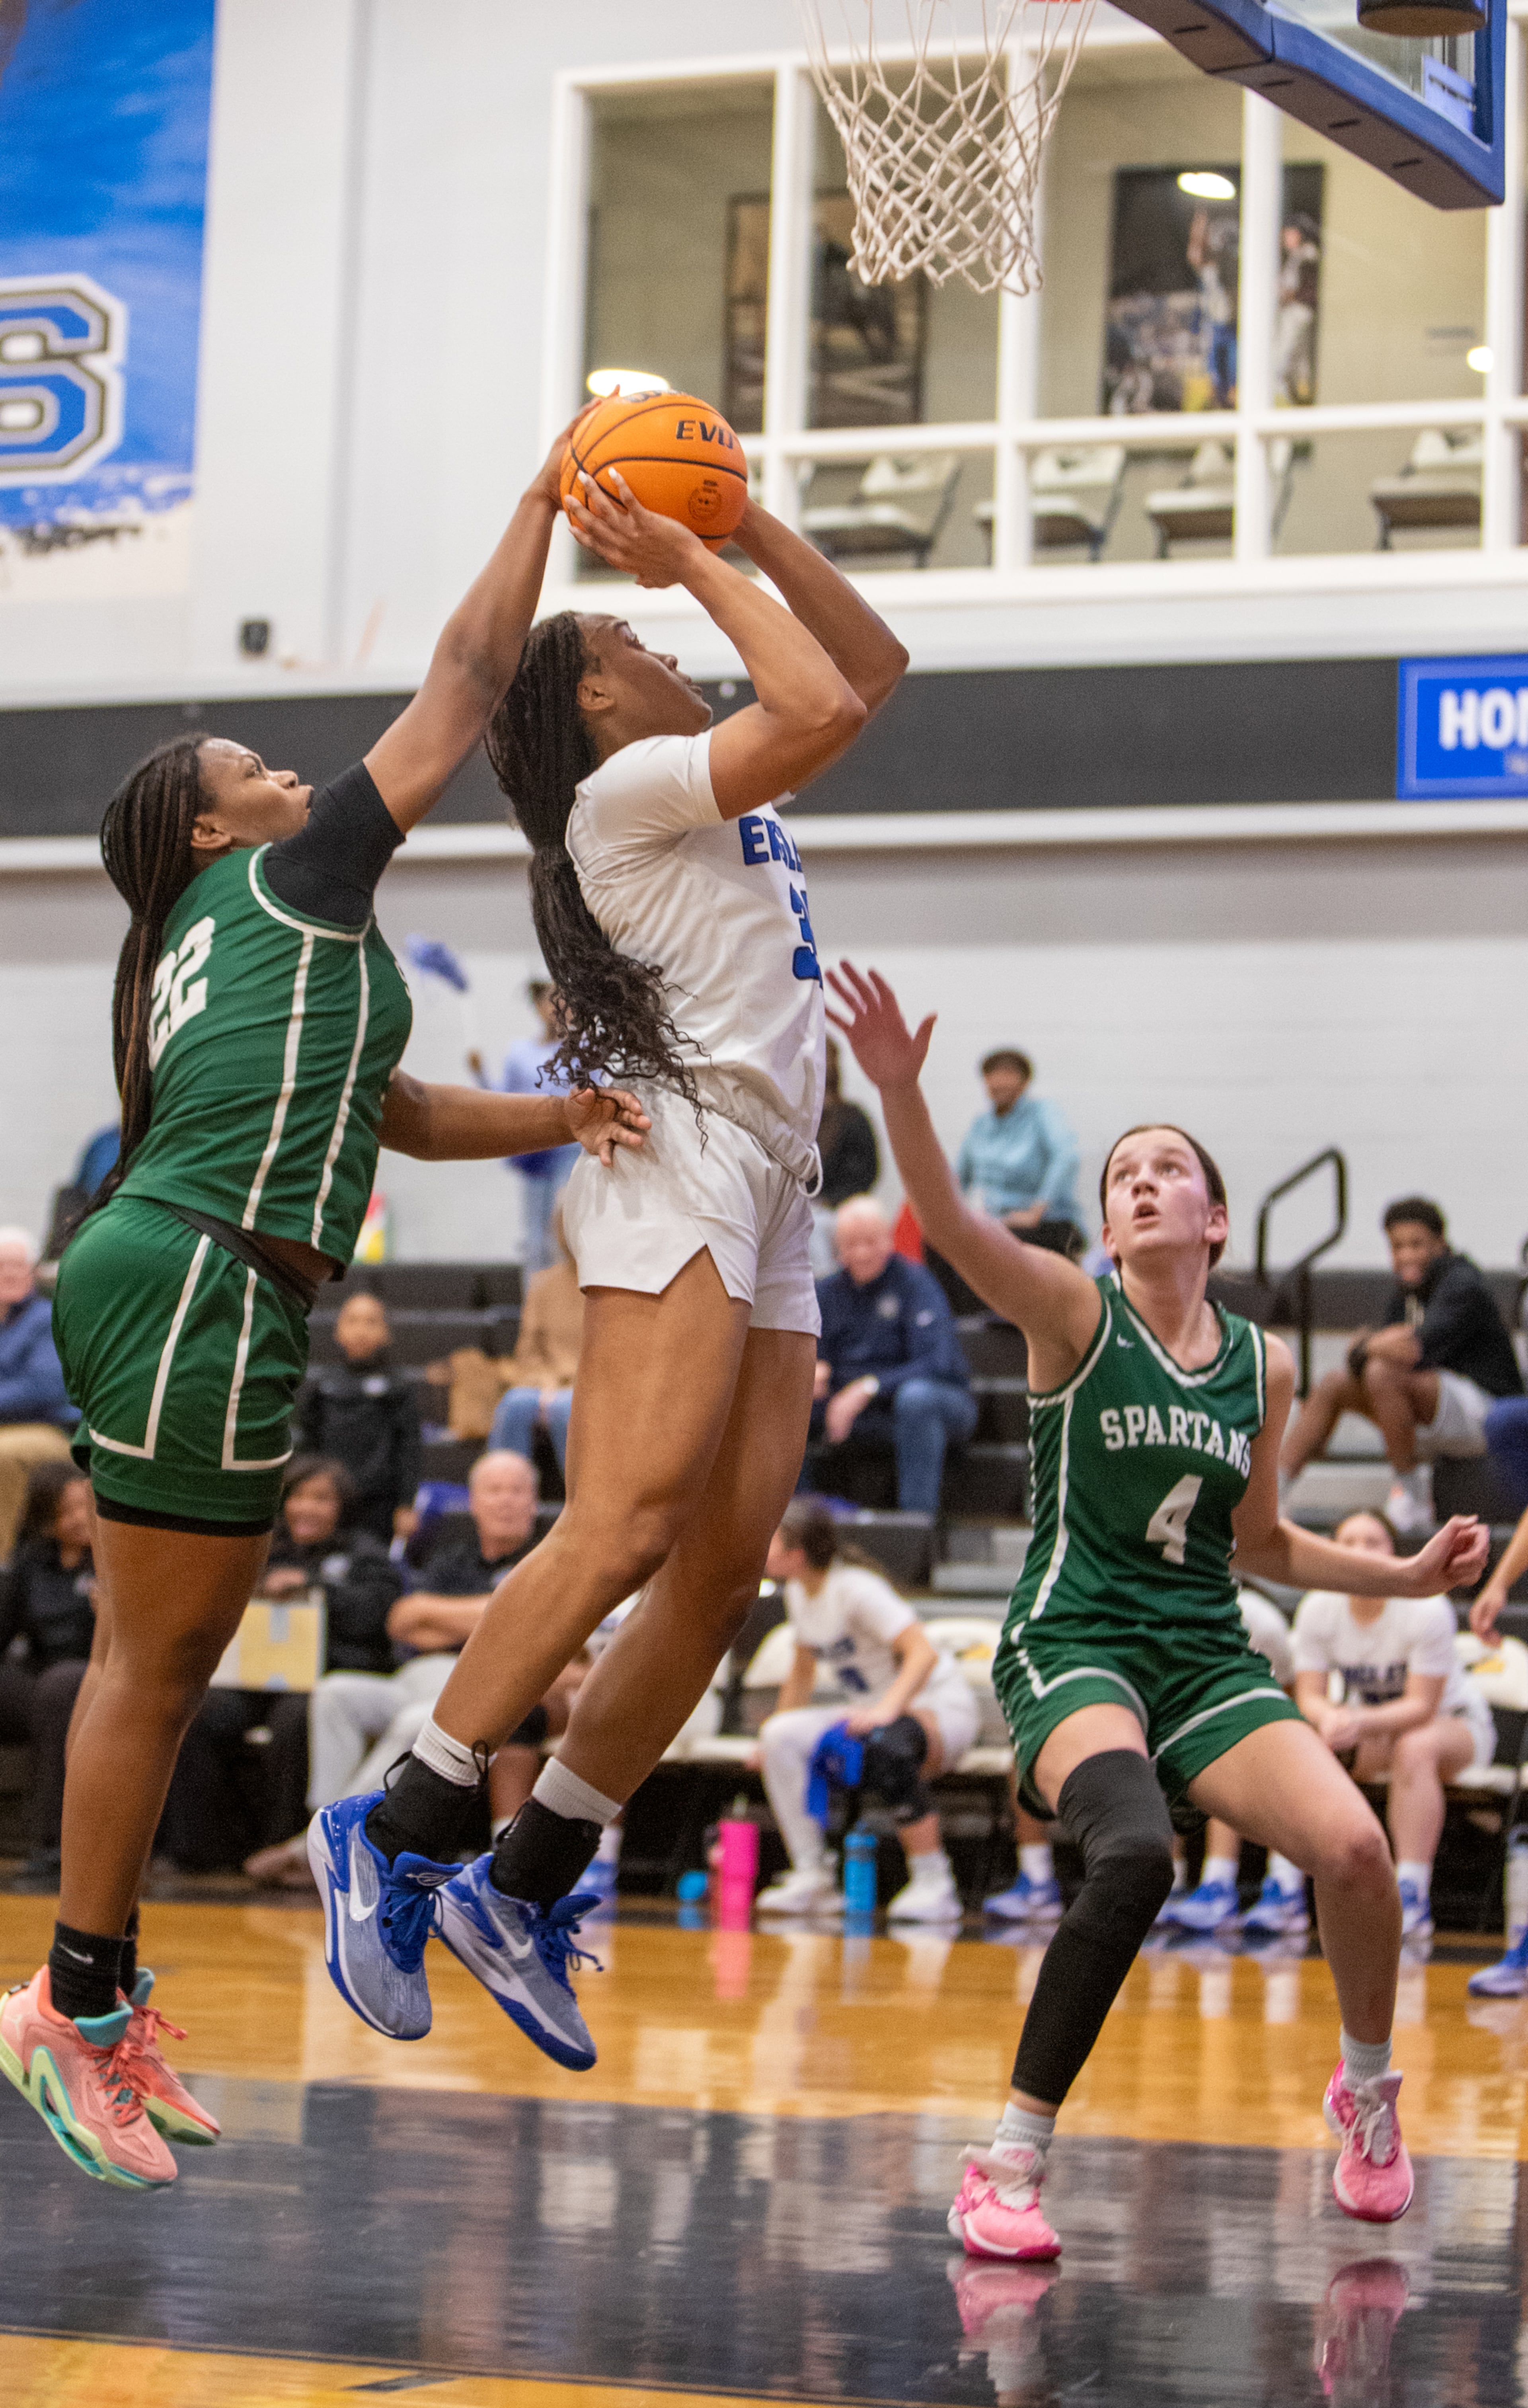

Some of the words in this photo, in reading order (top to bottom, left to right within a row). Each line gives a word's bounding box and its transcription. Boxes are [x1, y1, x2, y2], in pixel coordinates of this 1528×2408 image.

[1437, 686, 1528, 751] HO
[148, 916, 216, 1073] 22
[1099, 1405, 1251, 1479] SPARTANS
[1145, 1473, 1203, 1565] 4
